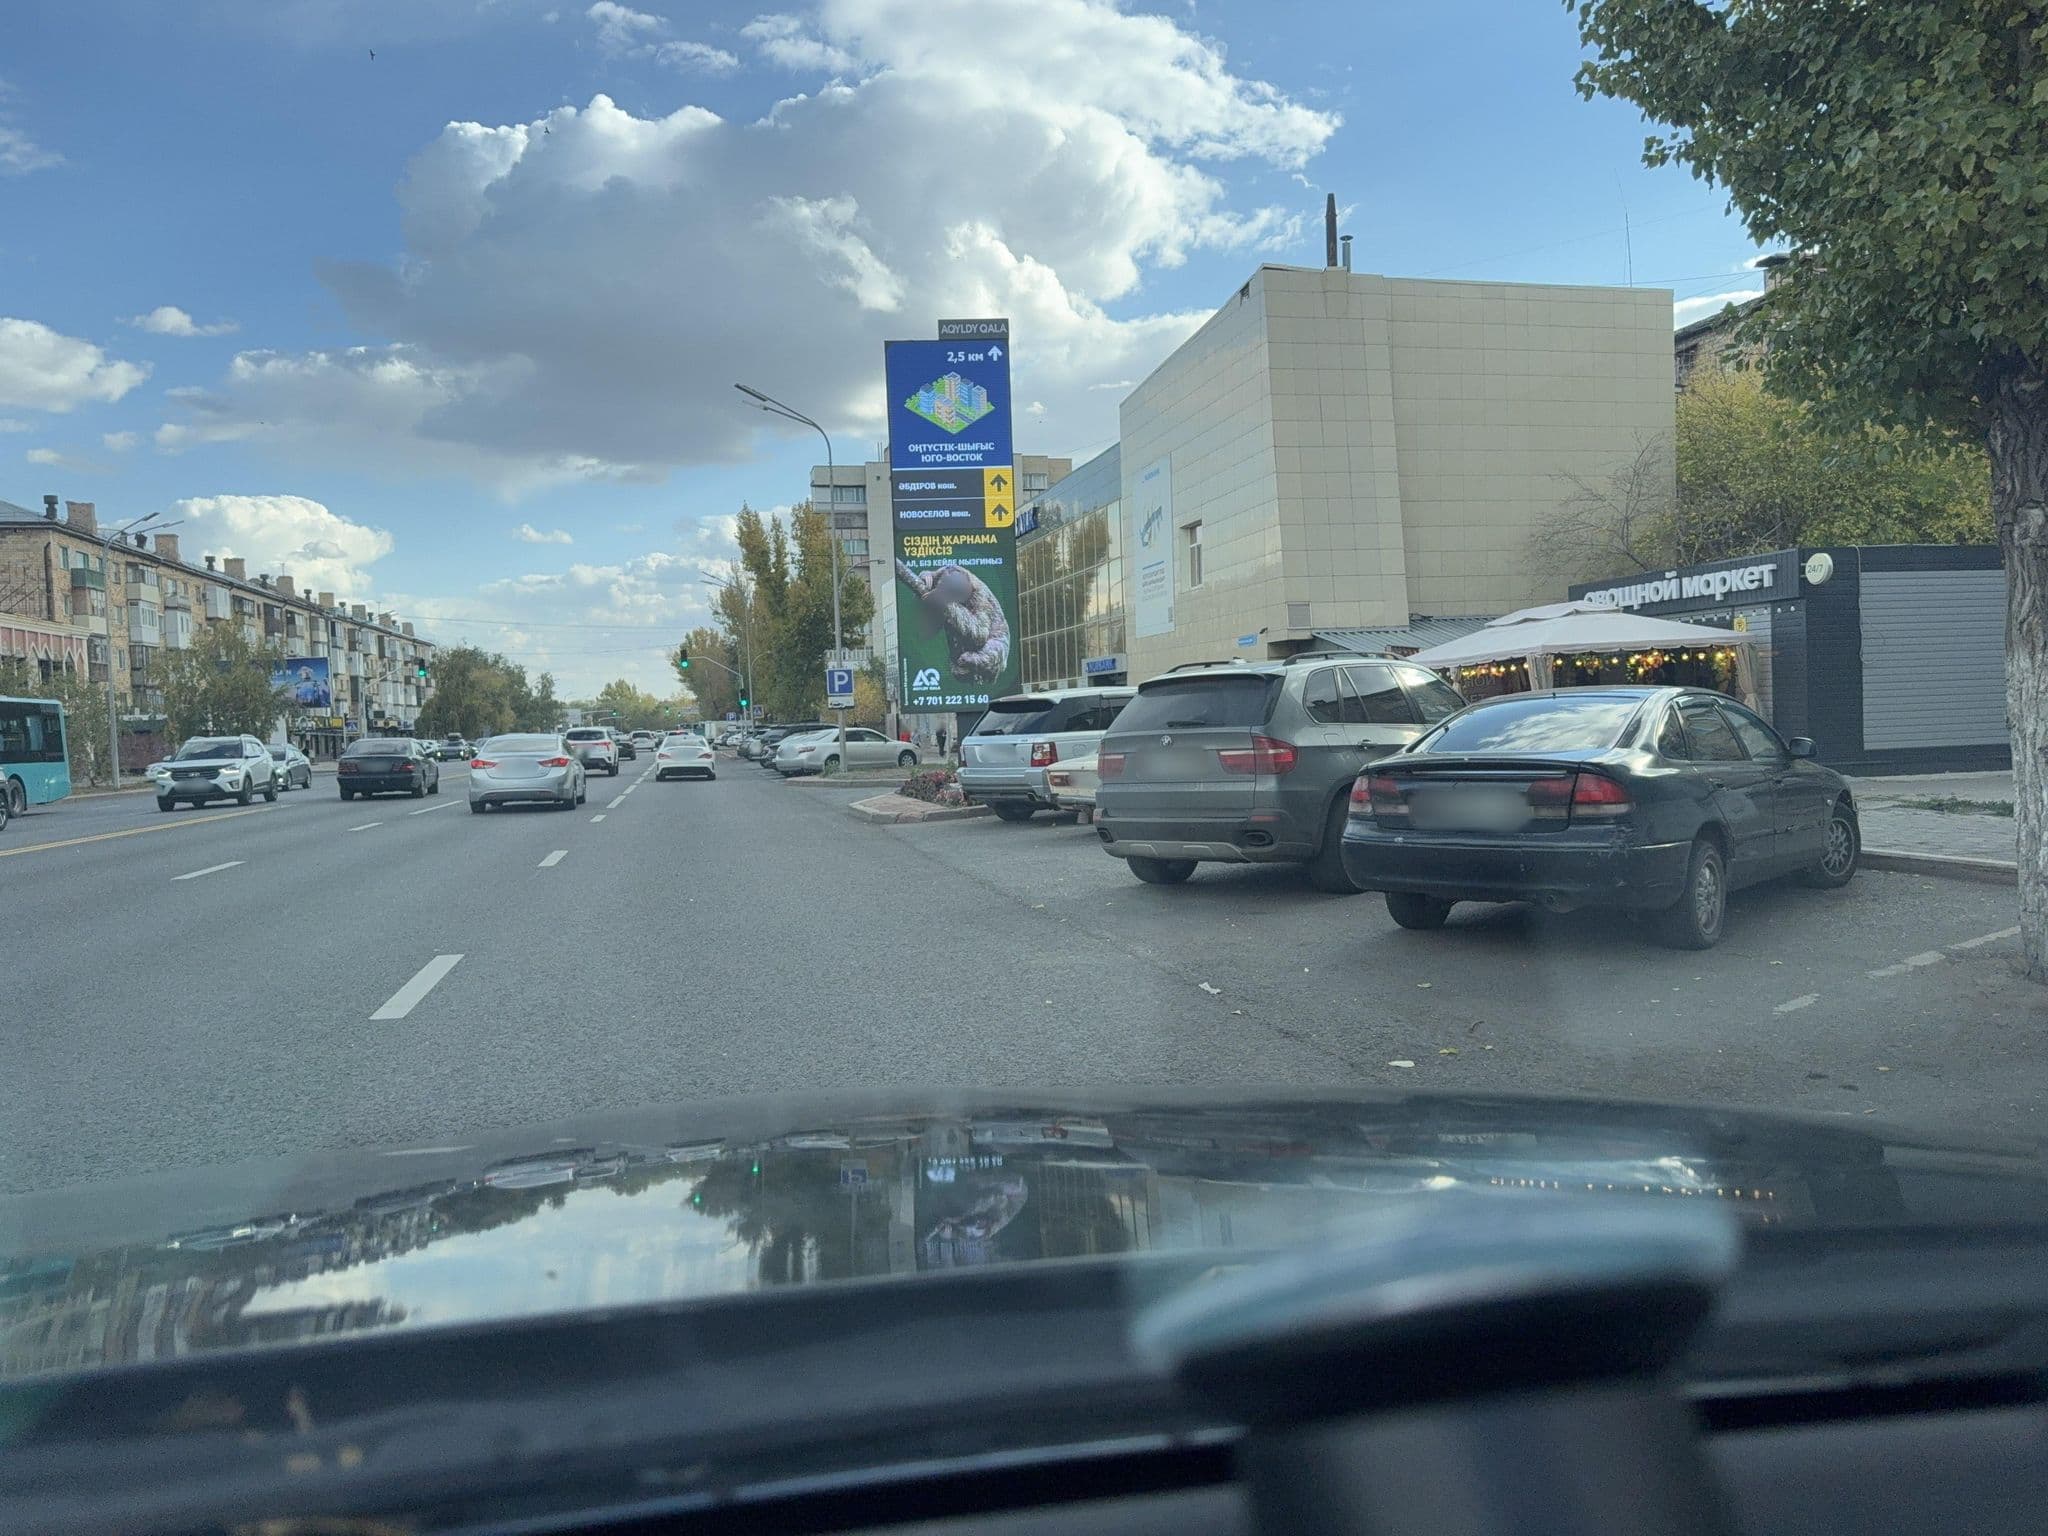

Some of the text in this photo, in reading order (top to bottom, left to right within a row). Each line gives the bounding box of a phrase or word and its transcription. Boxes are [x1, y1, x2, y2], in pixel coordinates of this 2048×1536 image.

[941, 323, 1008, 334] AQYLDY QALA
[947, 351, 984, 364] 2,5 км
[921, 453, 983, 462] ЮГО-ВОСТОК
[899, 510, 950, 519] НОВОСЕЛОВ
[903, 534, 998, 547] СІЗДІҢ ЖАРНАМА
[1806, 564, 1824, 574] 24/7
[1682, 563, 1778, 601] маркет
[833, 671, 849, 692] P
[912, 694, 989, 706] +7 701 222 15 60
